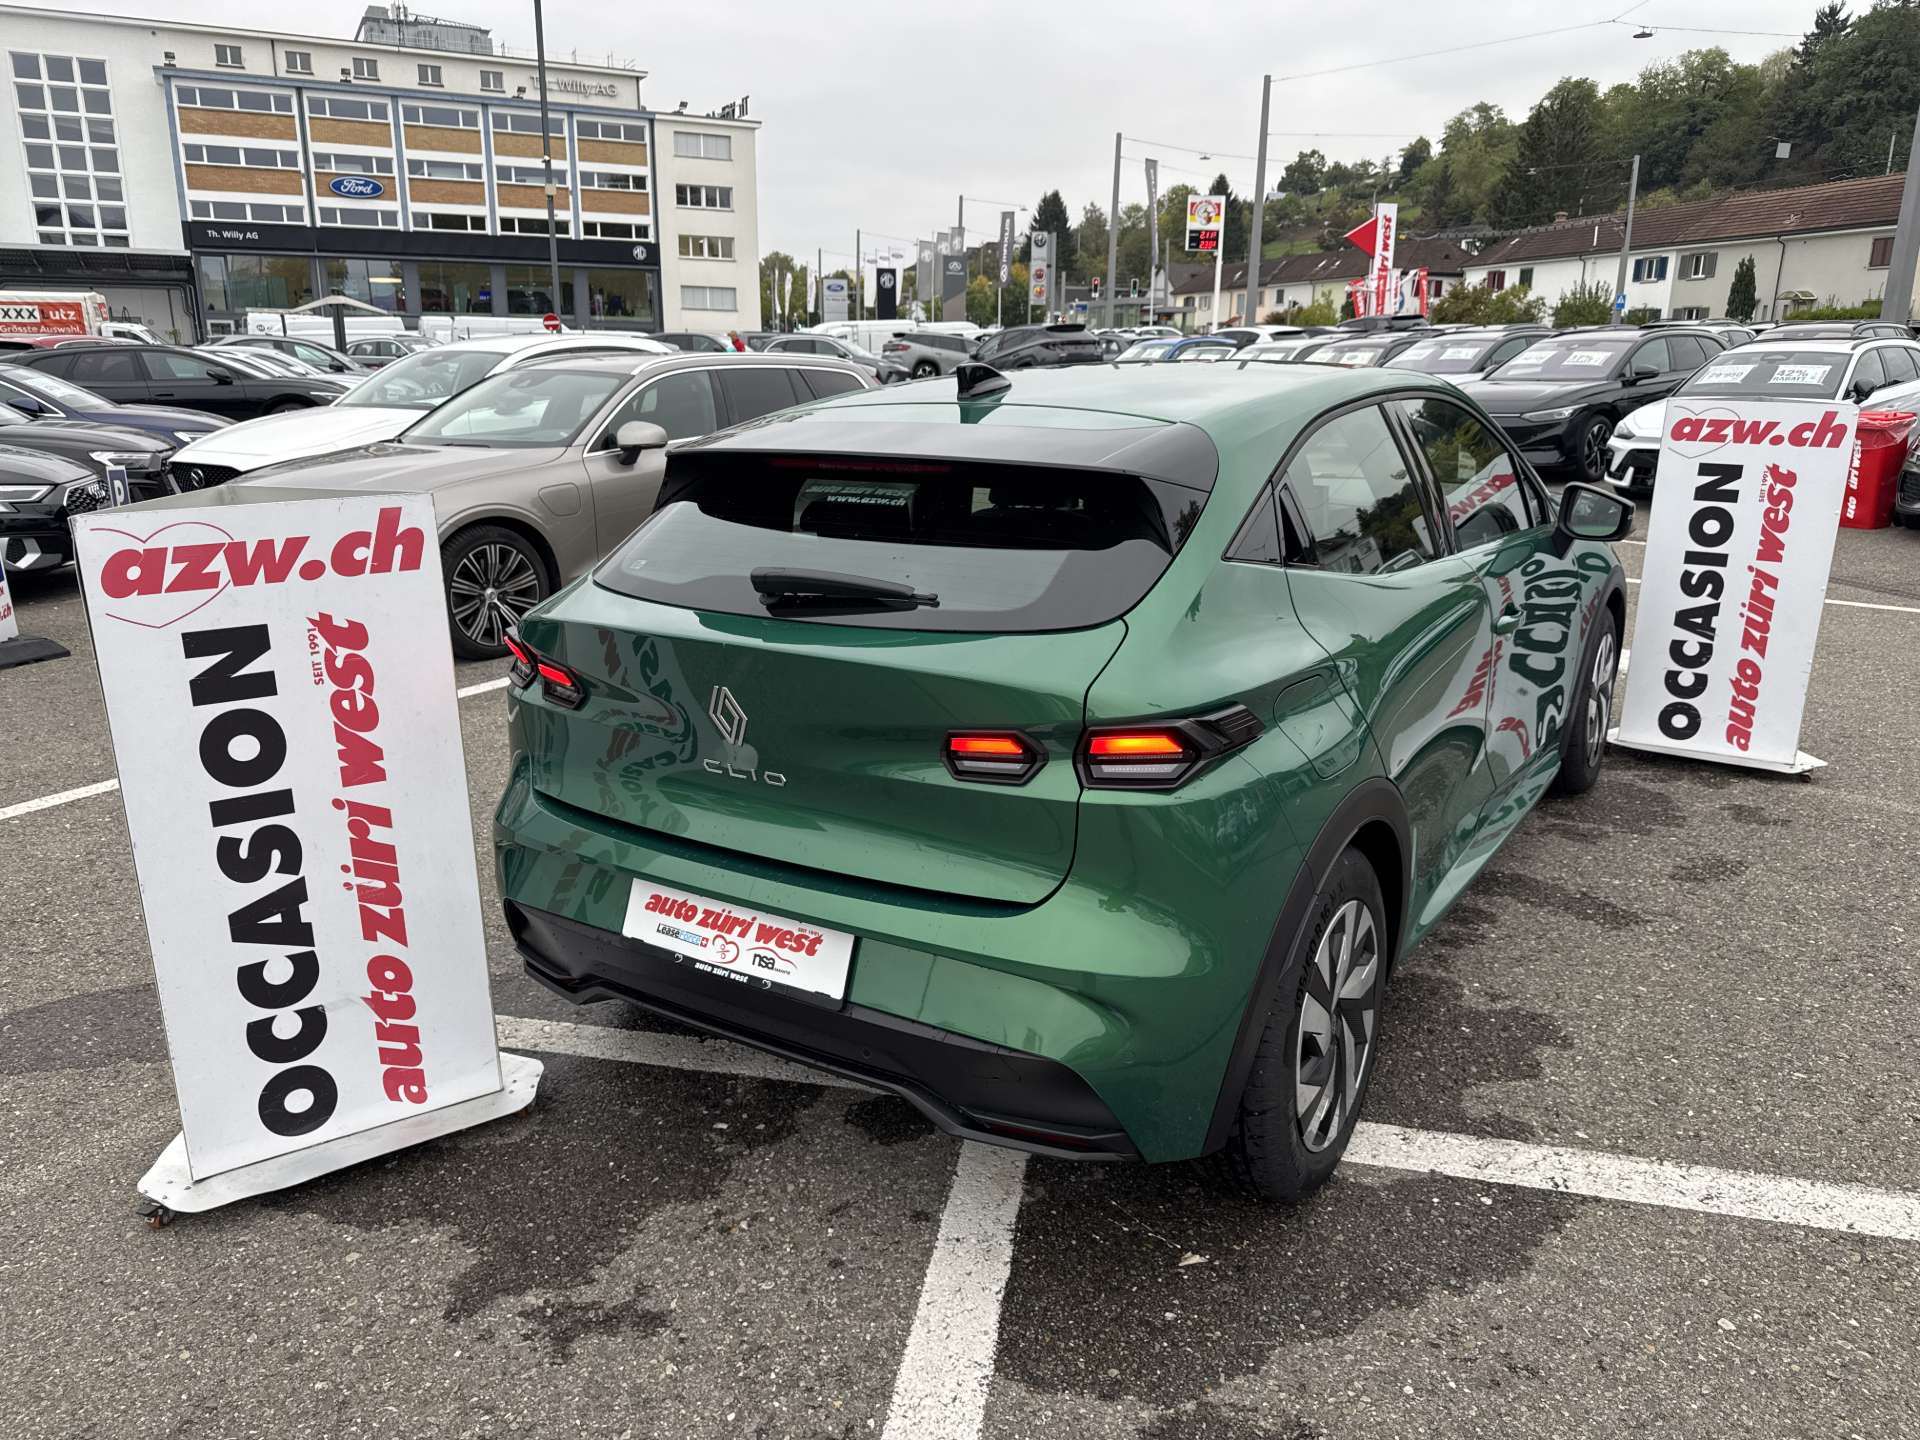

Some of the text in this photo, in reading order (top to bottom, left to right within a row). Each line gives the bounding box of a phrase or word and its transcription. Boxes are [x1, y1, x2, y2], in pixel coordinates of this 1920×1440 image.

[341, 179, 373, 194] Ford
[206, 230, 259, 240] Th. Willy AG
[1382, 214, 1392, 252] west
[1670, 411, 1849, 449] azw.ch
[826, 495, 907, 506] www.azw.ch
[1758, 469, 1769, 503] SEIT 1991
[100, 507, 425, 600] azw.ch
[1658, 462, 1744, 741] OCCASION
[1725, 463, 1798, 752] auto züri west
[307, 628, 325, 685] SEIT 1991
[703, 759, 787, 786] CLIO
[306, 611, 428, 1104] auto züri west
[181, 623, 338, 1137] OCCASION
[644, 893, 824, 957] auto züri west
[694, 962, 712, 972] auto
[730, 972, 749, 983] west
[752, 953, 775, 970] nsa
